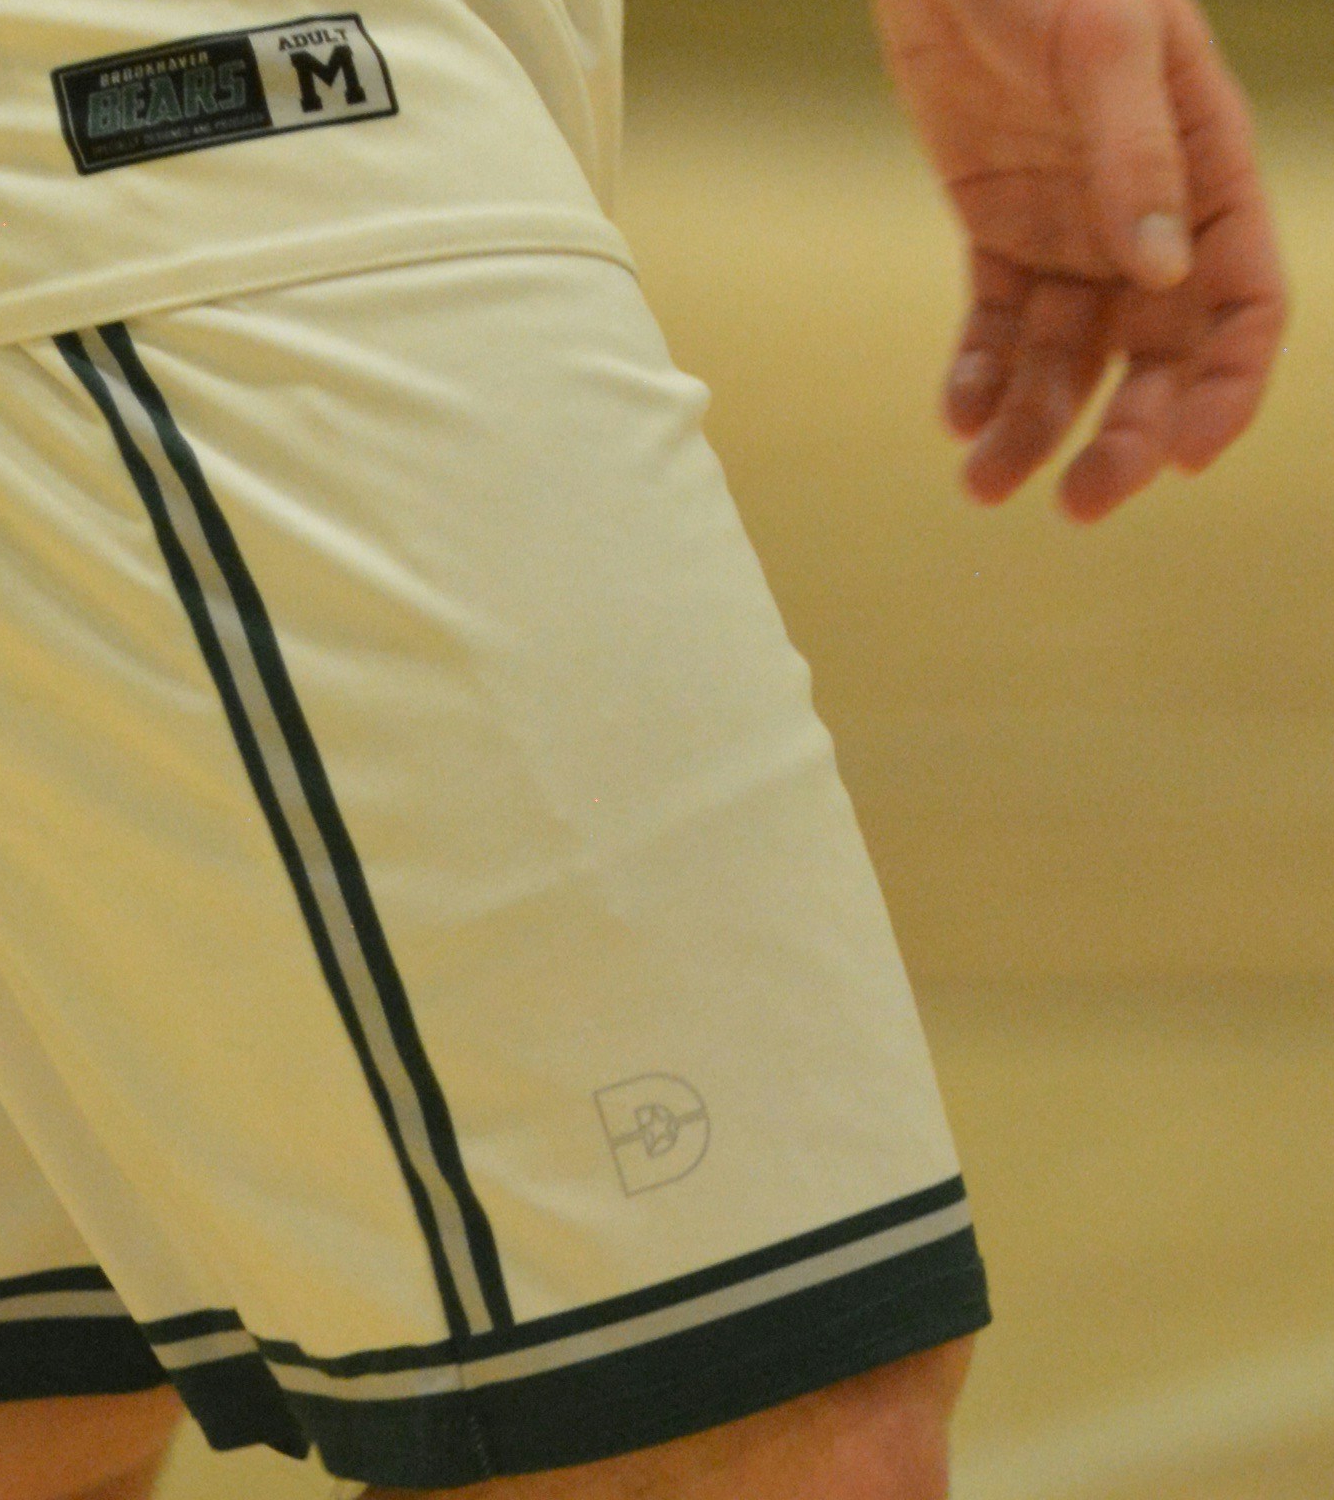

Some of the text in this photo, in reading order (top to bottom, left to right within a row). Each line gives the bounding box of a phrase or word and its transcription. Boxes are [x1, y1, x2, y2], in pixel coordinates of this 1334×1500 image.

[278, 28, 349, 52] ADULT
[87, 59, 247, 138] BEARS
[289, 45, 367, 113] M
